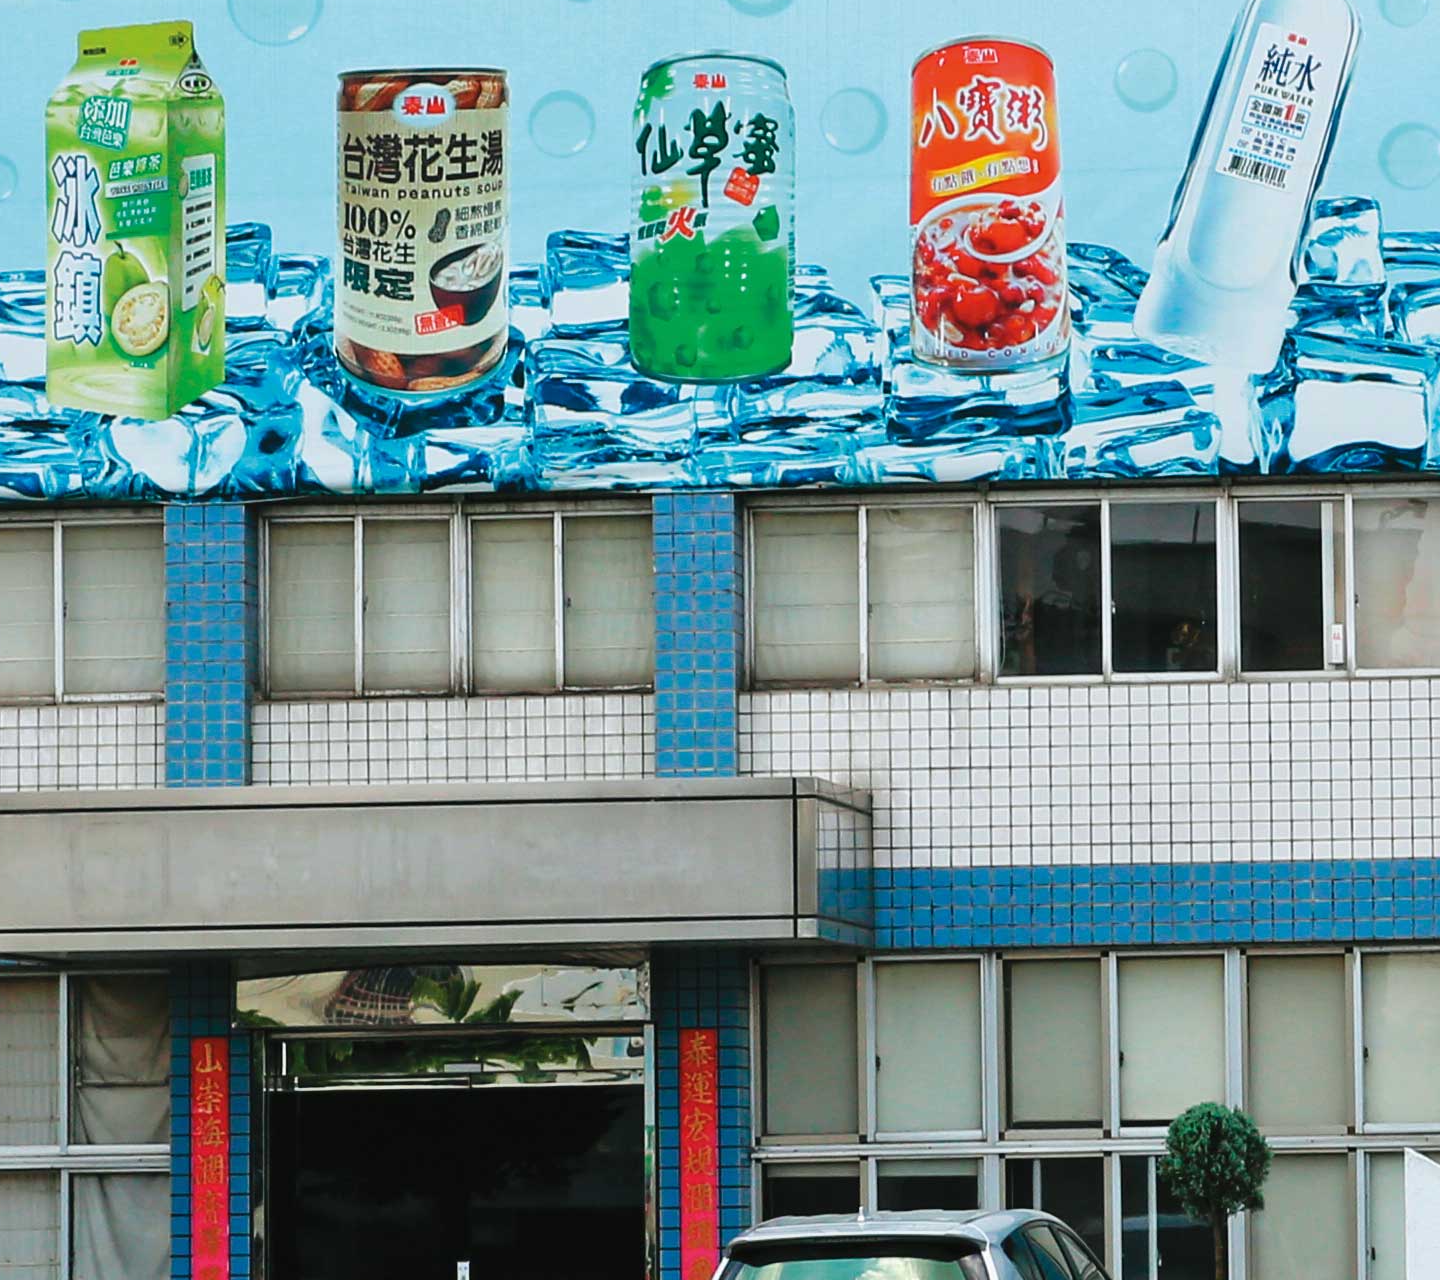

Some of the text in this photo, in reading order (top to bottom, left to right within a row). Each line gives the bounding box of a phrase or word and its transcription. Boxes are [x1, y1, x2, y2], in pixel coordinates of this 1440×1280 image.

[692, 73, 726, 89] 泰山
[1258, 43, 1323, 93] 純水
[84, 96, 129, 129] 添加
[401, 95, 446, 116] 泰山
[918, 74, 1048, 152] 八寶粥
[1254, 83, 1314, 108] PURE WATER
[343, 129, 504, 184] 台灣花生湯
[635, 99, 780, 208] 仙草蜜
[345, 180, 503, 200] Taiwan peanuts soup
[343, 202, 417, 239] 100%
[51, 154, 103, 347] 冰鎮
[343, 233, 417, 265] 台灣花生
[343, 257, 415, 301] 限定
